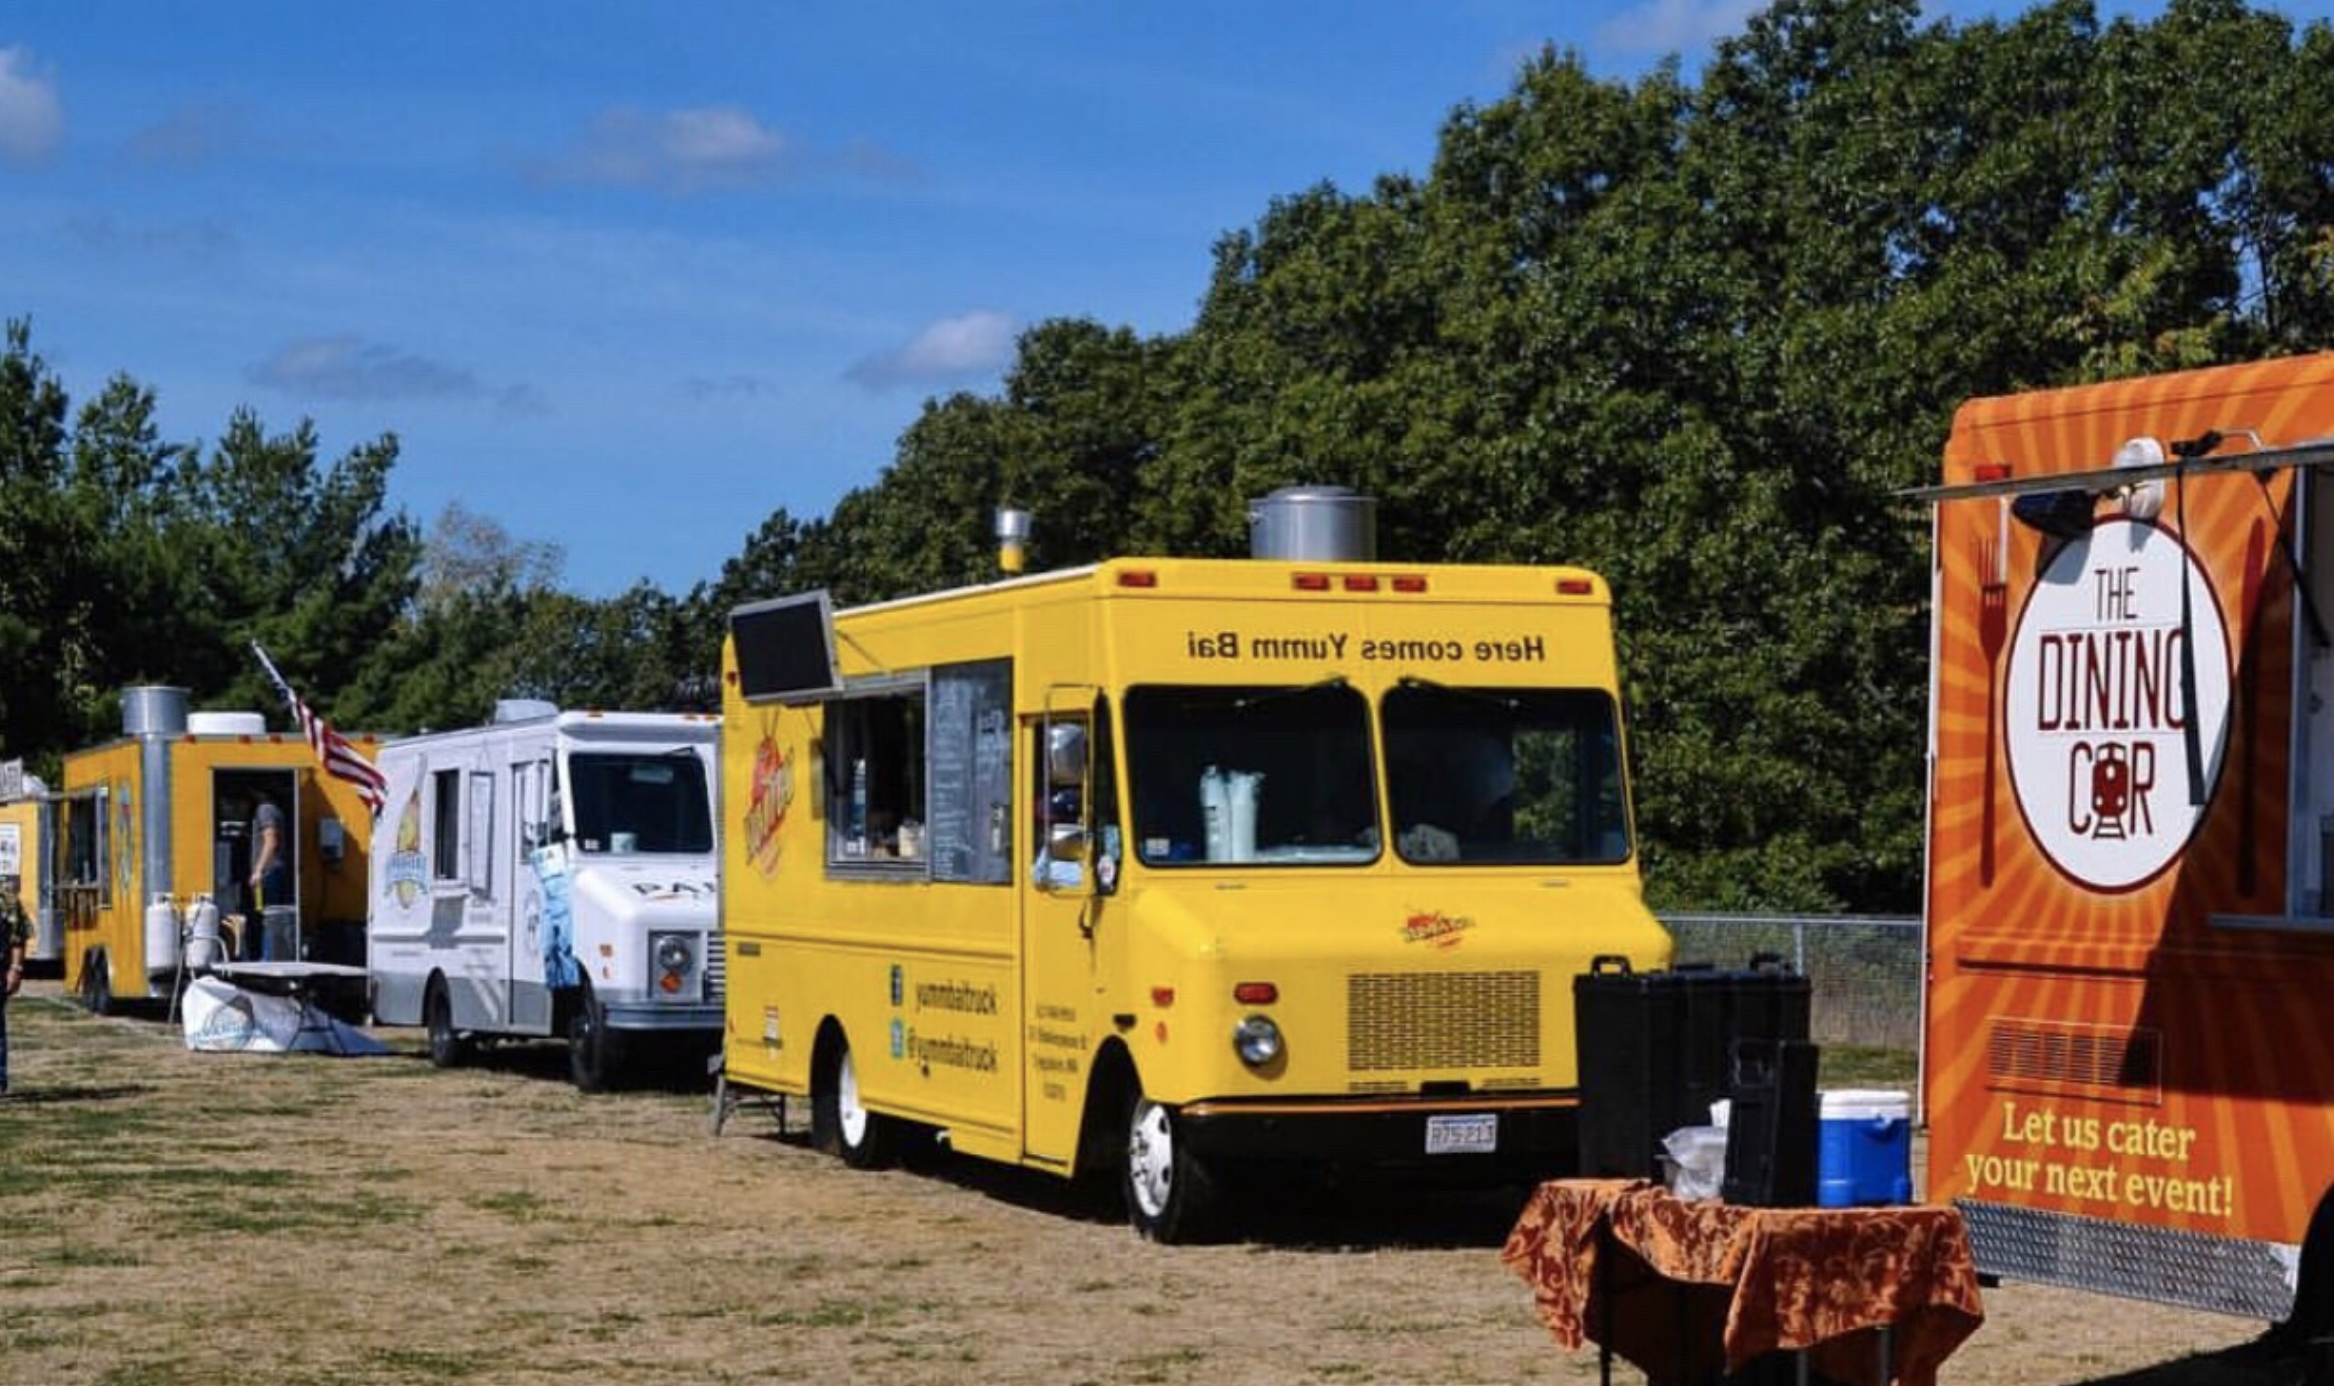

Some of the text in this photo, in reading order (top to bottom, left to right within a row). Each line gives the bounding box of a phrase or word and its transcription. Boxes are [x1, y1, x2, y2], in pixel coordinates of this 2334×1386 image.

[2094, 567, 2140, 621] THE
[2003, 1101, 2197, 1162] Let us cater
[1965, 1153, 2234, 1218] your next event!
